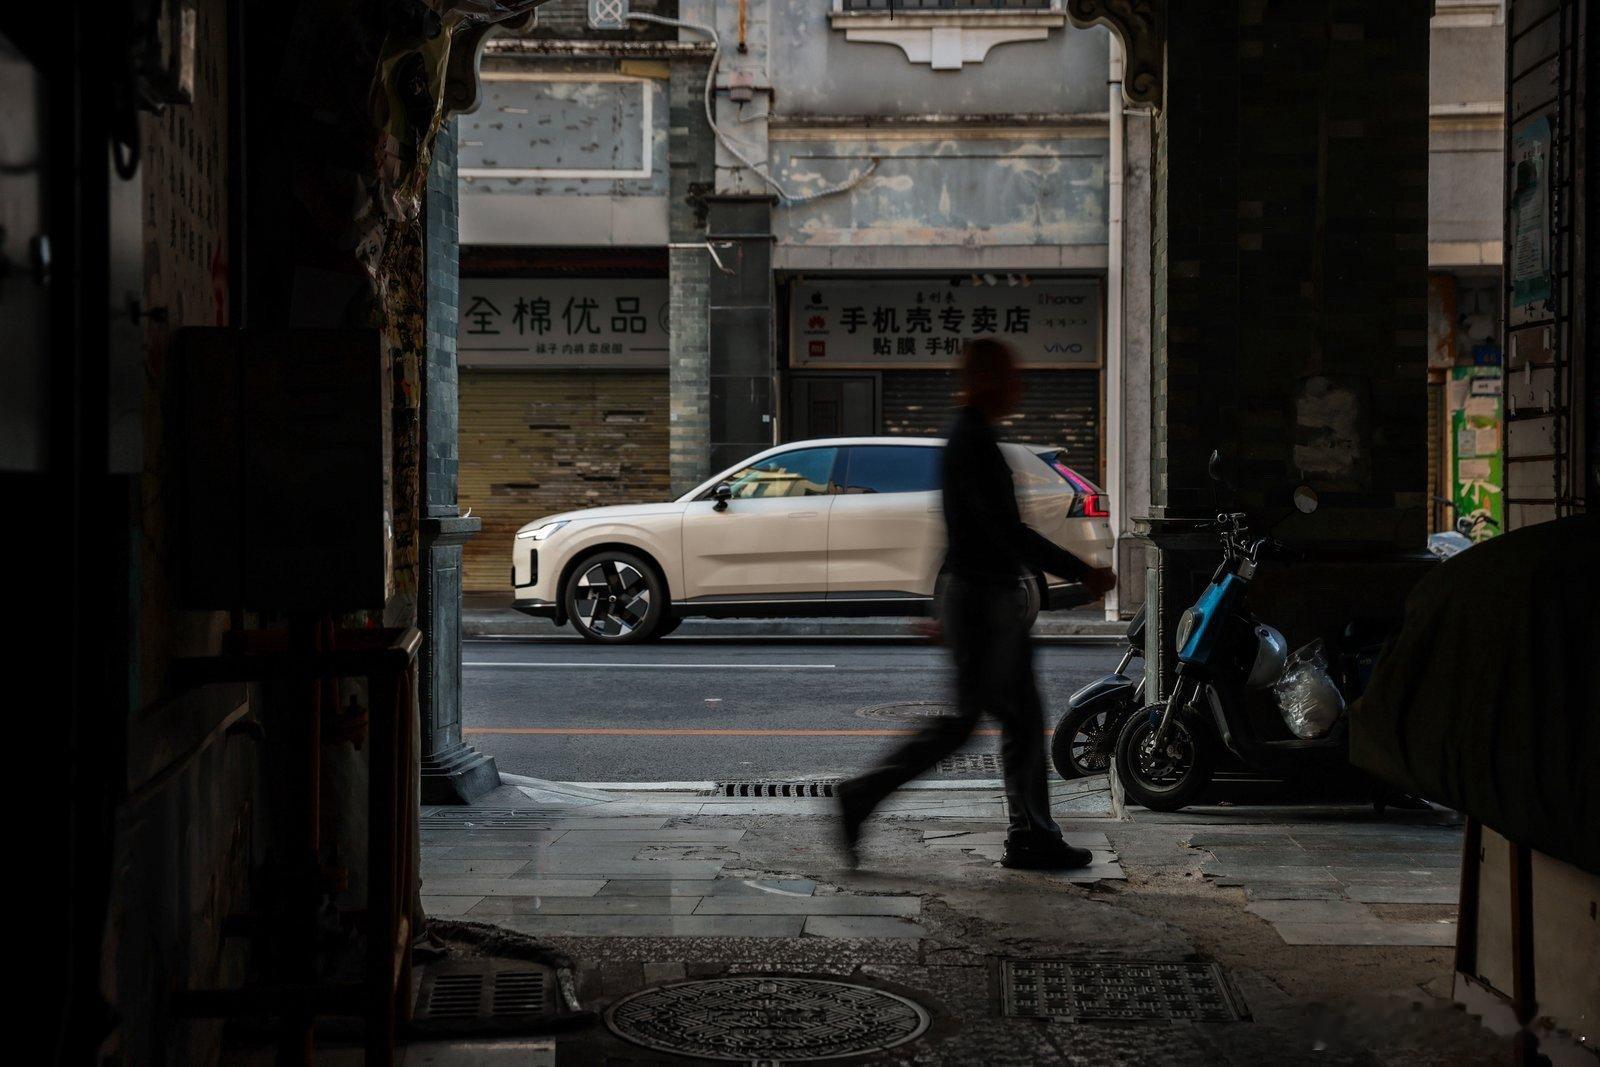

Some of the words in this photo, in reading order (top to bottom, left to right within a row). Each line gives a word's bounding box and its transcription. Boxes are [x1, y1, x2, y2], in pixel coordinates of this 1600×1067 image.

[465, 296, 647, 336] 全棉优品
[839, 306, 1031, 334] 手机壳专卖店
[872, 337, 916, 356] 贴膜
[925, 337, 974, 356] 手机
[1043, 342, 1083, 354] vivo
